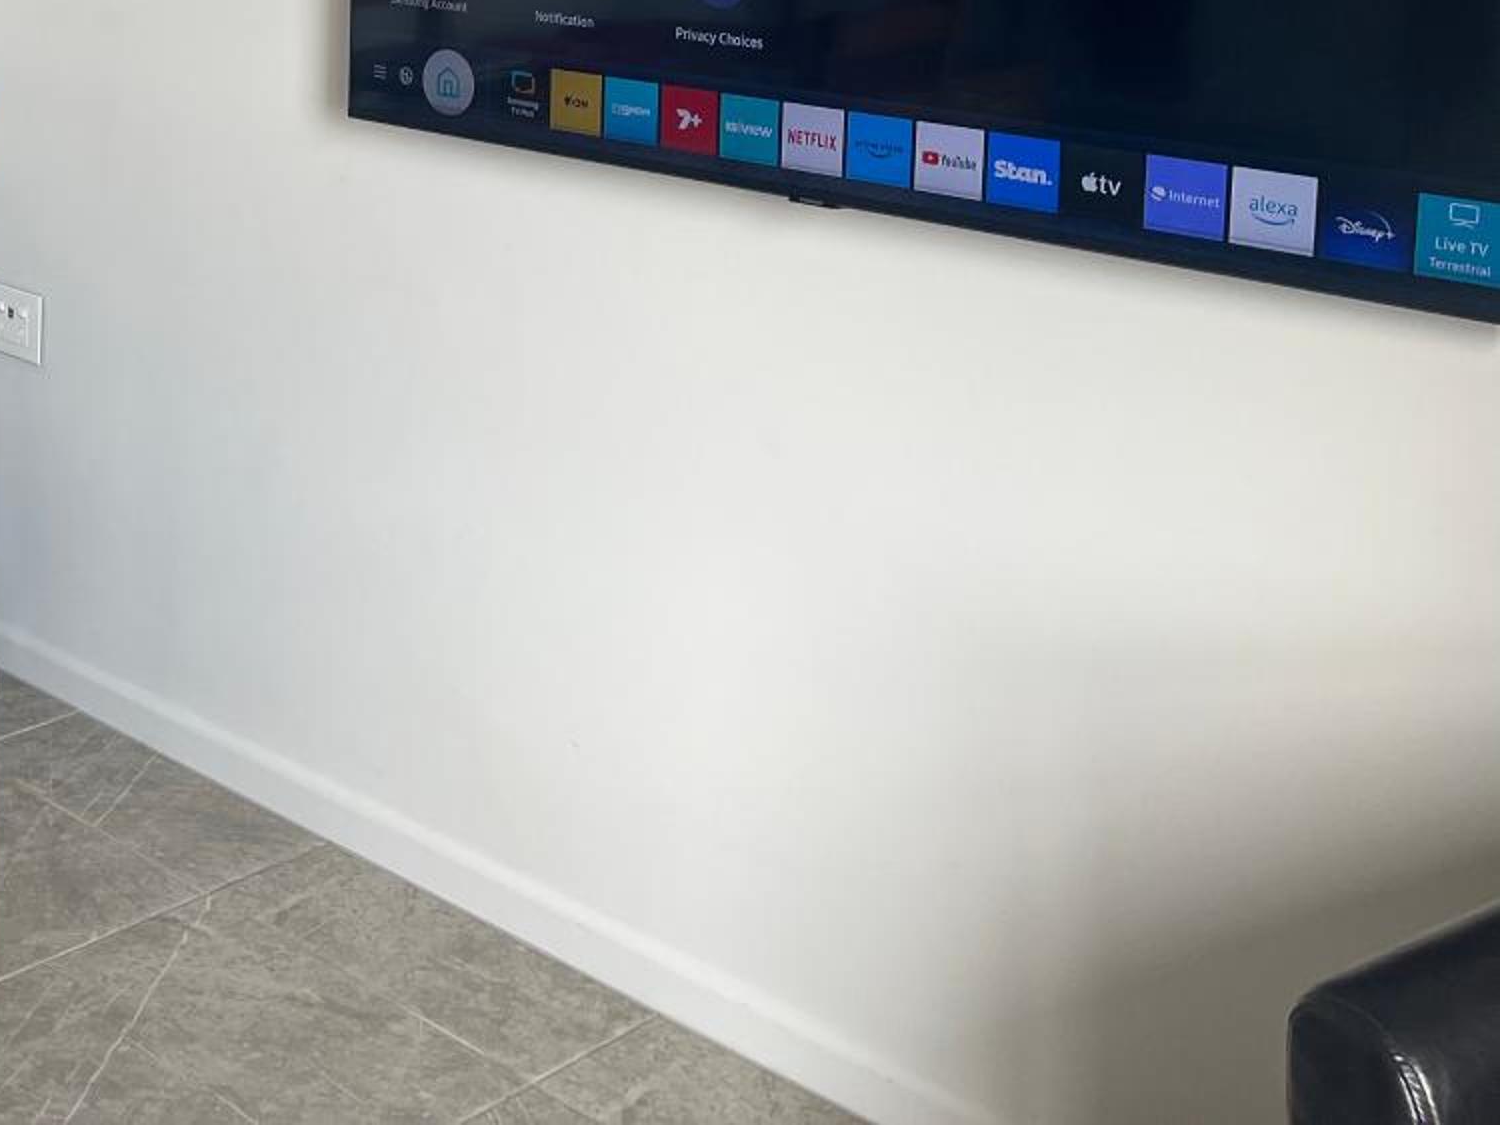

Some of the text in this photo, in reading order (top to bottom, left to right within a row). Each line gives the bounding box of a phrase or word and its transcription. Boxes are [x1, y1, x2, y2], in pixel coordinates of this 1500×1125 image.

[534, 10, 596, 28] Notification
[675, 26, 763, 50] Privacy Choices
[787, 128, 837, 152] NETFLIX
[941, 153, 978, 171] YouTube
[1099, 176, 1122, 197] tv
[1168, 189, 1221, 210] Internet
[1248, 193, 1299, 217] alexa
[1434, 236, 1490, 258] Live TV
